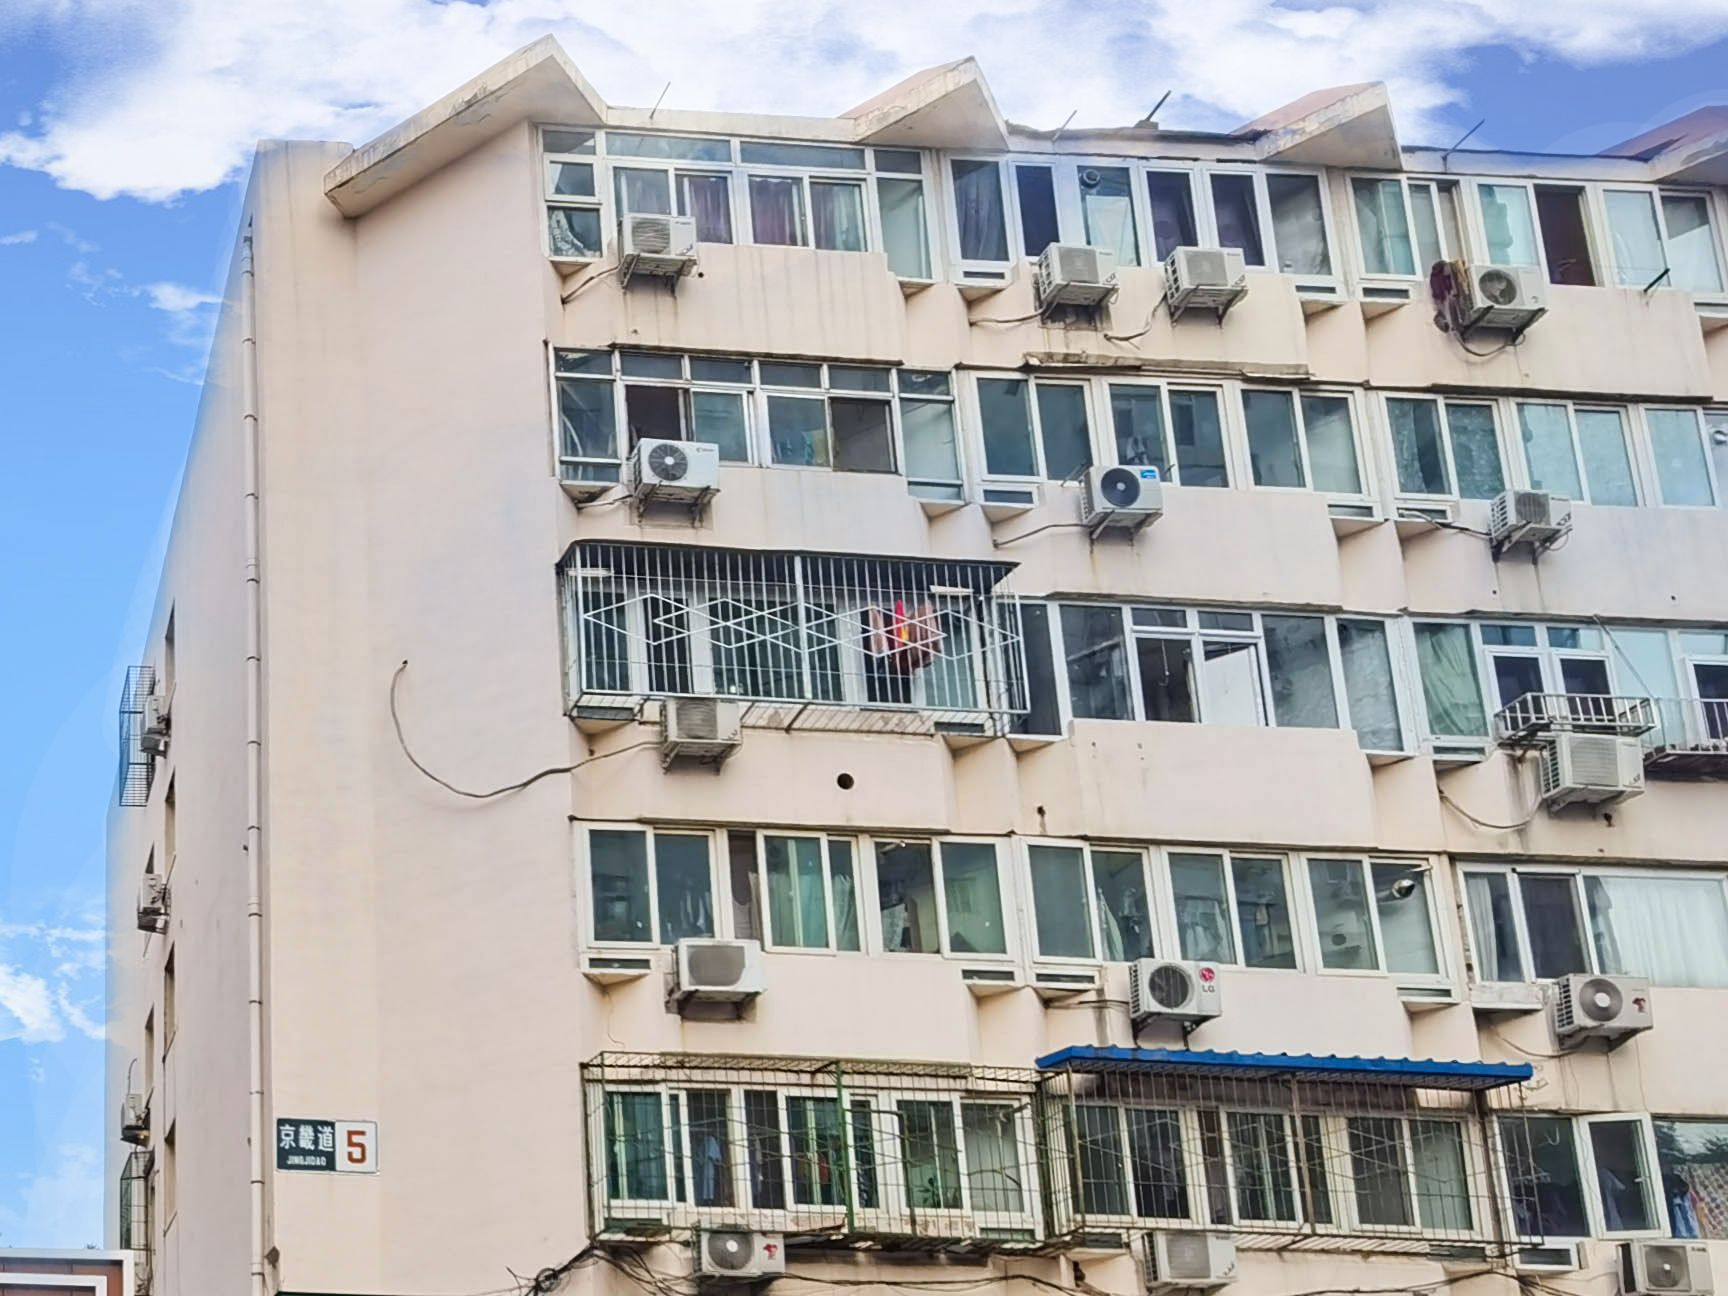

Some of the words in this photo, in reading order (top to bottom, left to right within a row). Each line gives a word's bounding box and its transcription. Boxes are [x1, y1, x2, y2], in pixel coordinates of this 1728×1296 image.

[279, 1124, 334, 1151] 京畿道
[347, 1130, 366, 1164] 5
